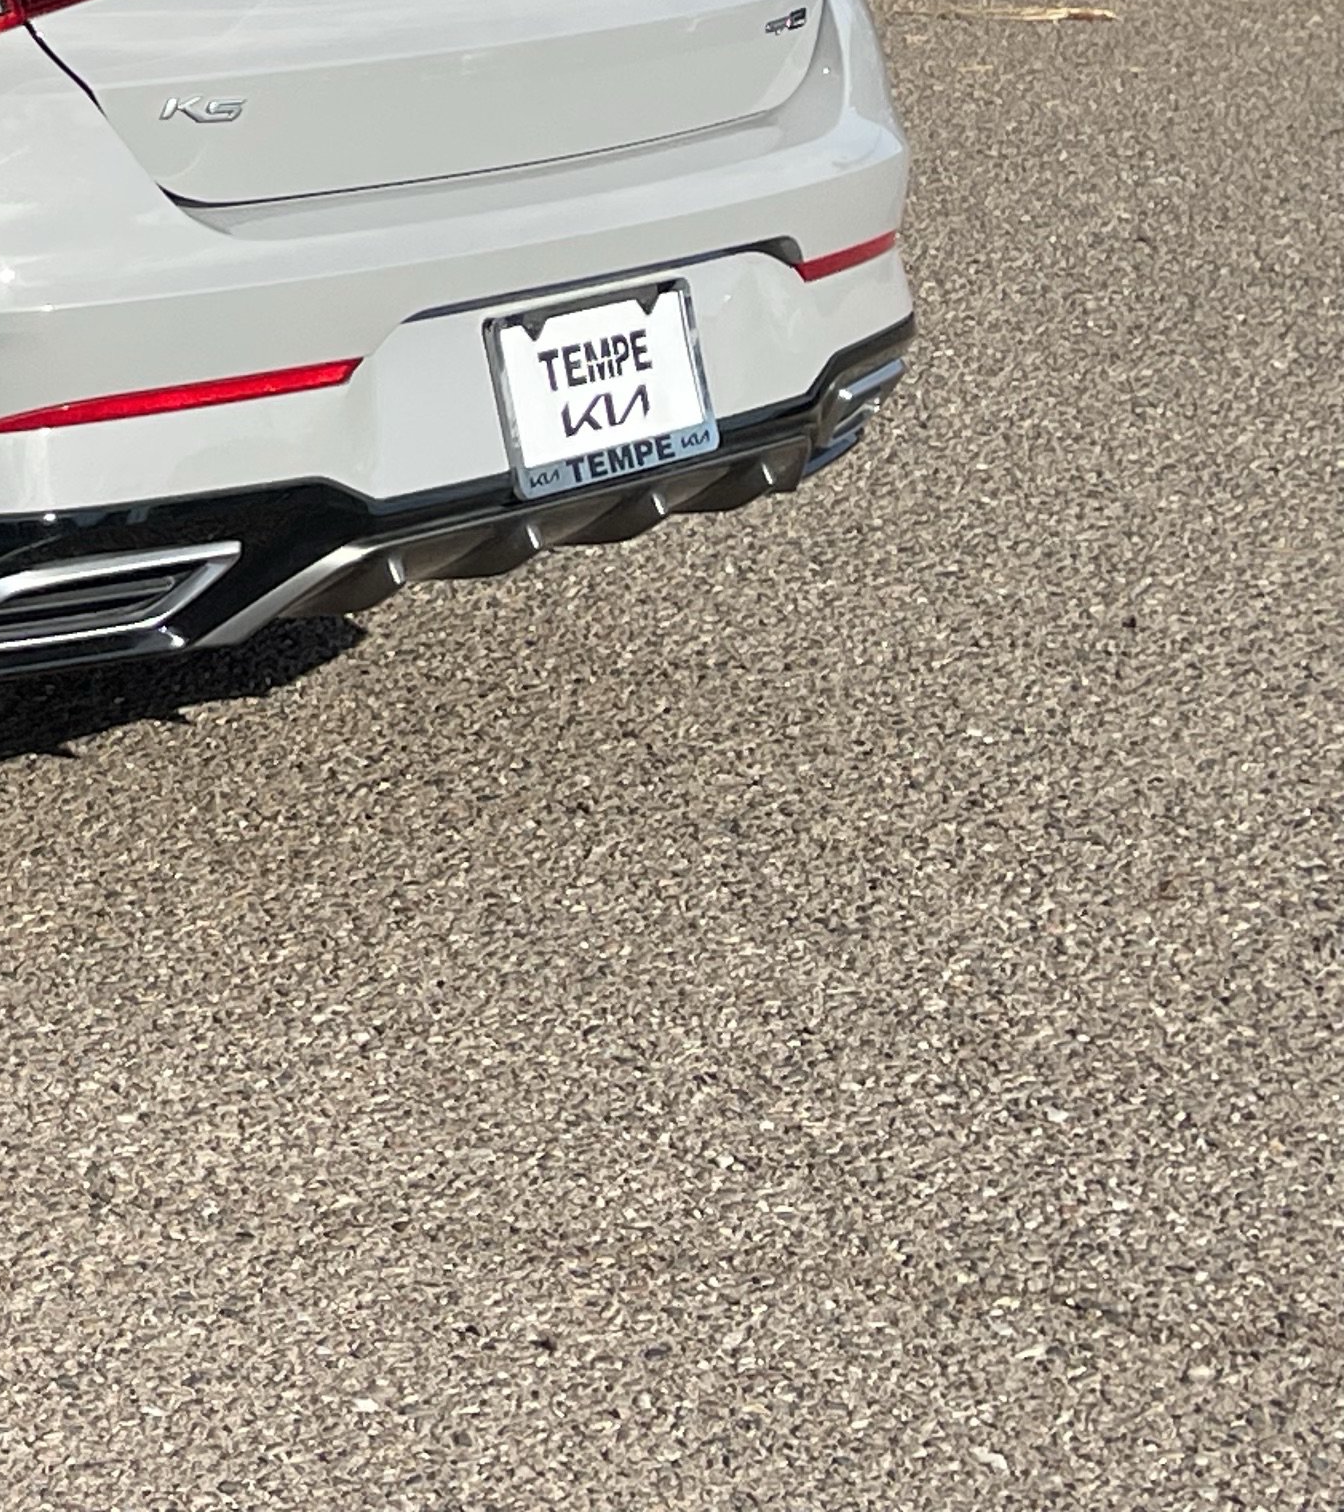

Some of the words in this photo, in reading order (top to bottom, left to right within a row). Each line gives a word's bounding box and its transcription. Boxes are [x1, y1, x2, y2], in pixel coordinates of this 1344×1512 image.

[159, 95, 247, 123] K5
[538, 329, 653, 391] TEMPE
[561, 385, 650, 438] KIA
[565, 435, 676, 483] TEMPE
